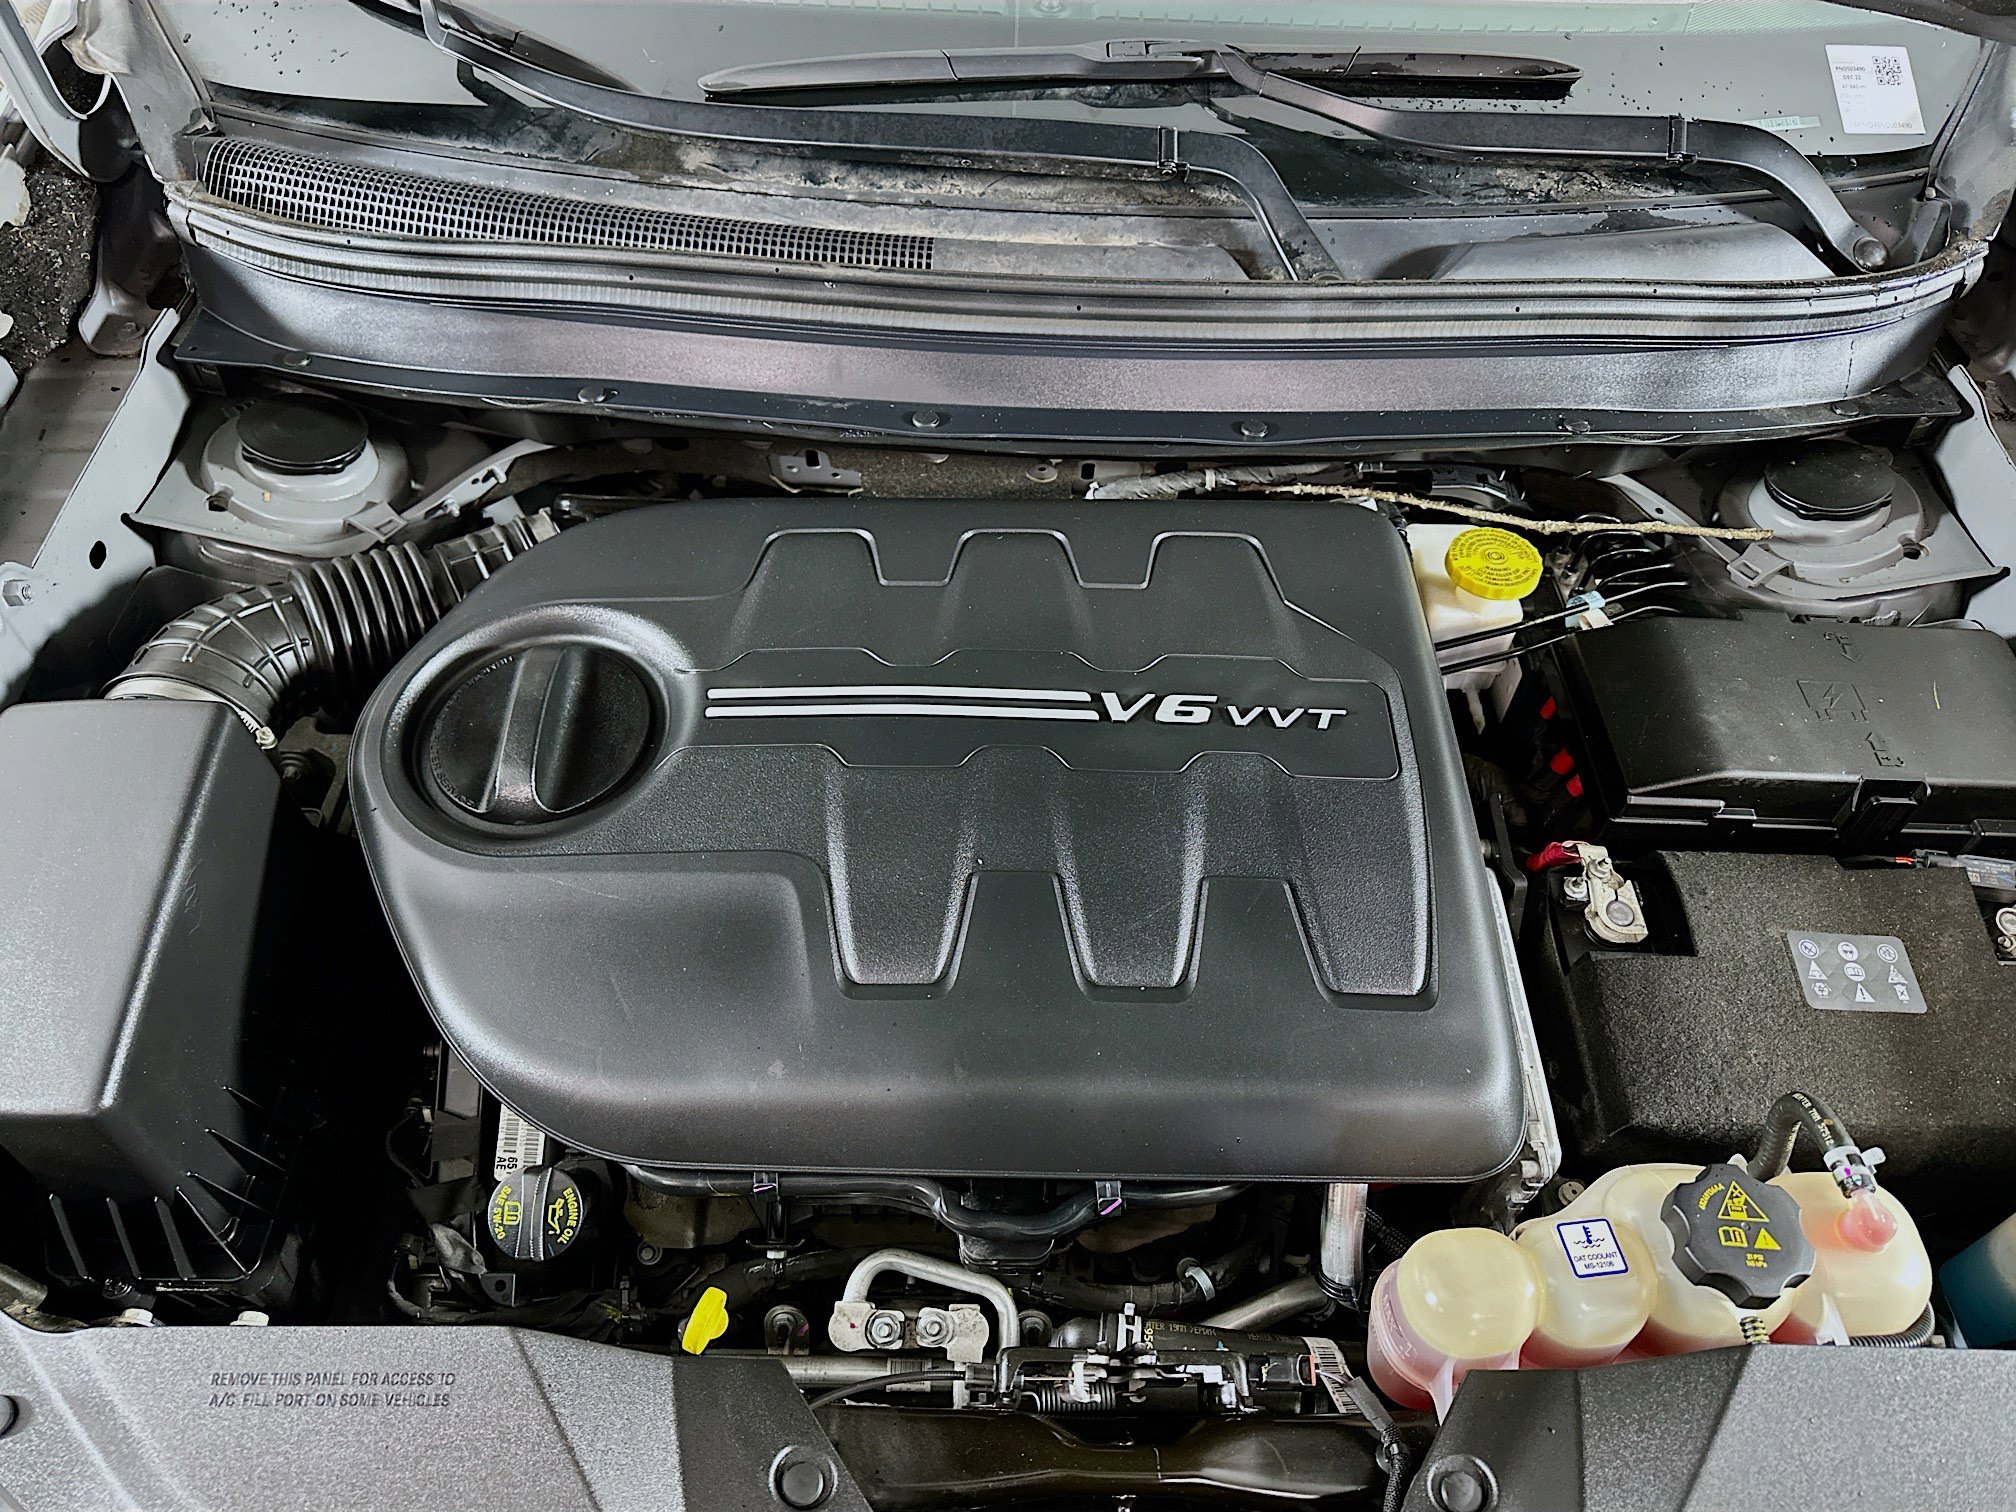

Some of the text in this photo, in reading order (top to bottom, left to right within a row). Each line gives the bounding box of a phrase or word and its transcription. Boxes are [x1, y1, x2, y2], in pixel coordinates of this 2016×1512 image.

[1100, 692, 1347, 730] V6 VVT
[437, 772, 475, 807] SERVICE
[496, 1156, 507, 1171] AE
[506, 1156, 518, 1170] 65
[492, 1185, 512, 1240] SAE 5W-20
[557, 1187, 579, 1245] ENGINE OIL
[1573, 1251, 1618, 1263] OAT COOLANT
[1584, 1260, 1615, 1269] MS-12106
[211, 1372, 456, 1386] REMOVE THIS PANEL FOR ACCESS TO
[208, 1393, 451, 1408] A/C FILL PORT ON SOME VEHICLES
